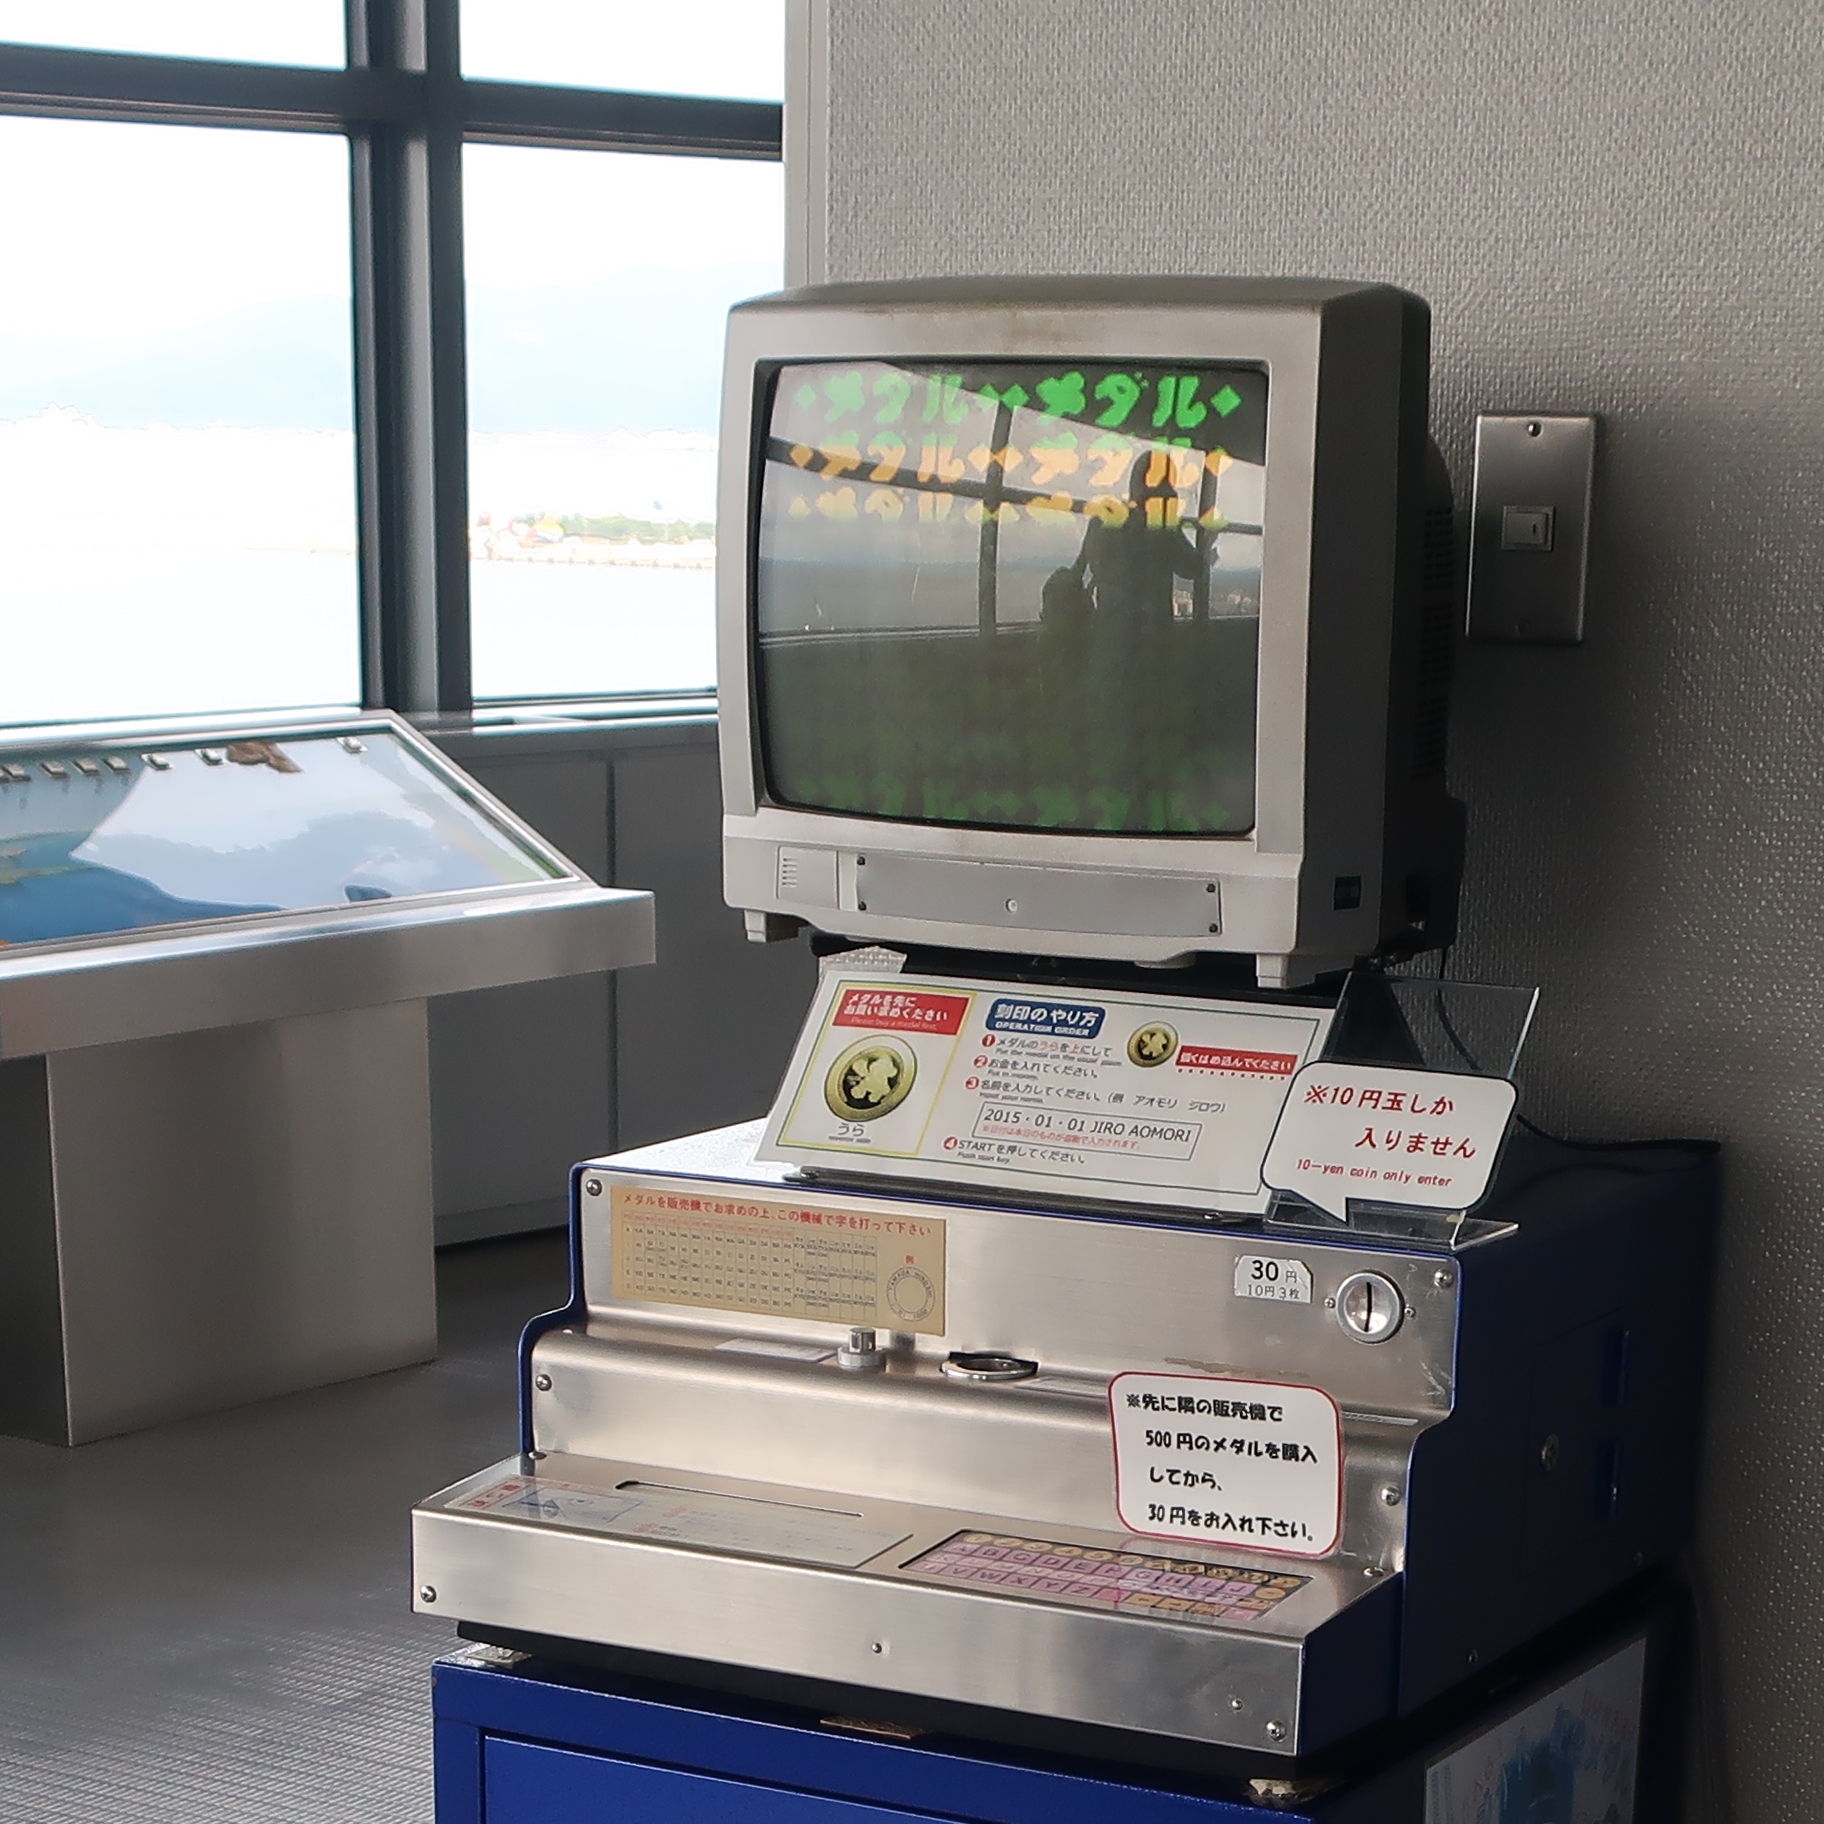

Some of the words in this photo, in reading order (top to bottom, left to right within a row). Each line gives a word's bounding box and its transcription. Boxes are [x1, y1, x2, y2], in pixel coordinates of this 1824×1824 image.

[994, 1002, 1100, 1028] 刻印のやり方
[836, 1123, 866, 1138] うら
[1090, 1121, 1126, 1136] JIRO
[1127, 1126, 1192, 1143] AOMORI
[1354, 1127, 1477, 1159] 入りません
[1349, 1166, 1378, 1180] coin
[1382, 1169, 1412, 1184] only
[1416, 1175, 1453, 1188] enter
[1149, 1466, 1224, 1492] してから、
[1147, 1503, 1314, 1542] 30円をお入れ下さい。
